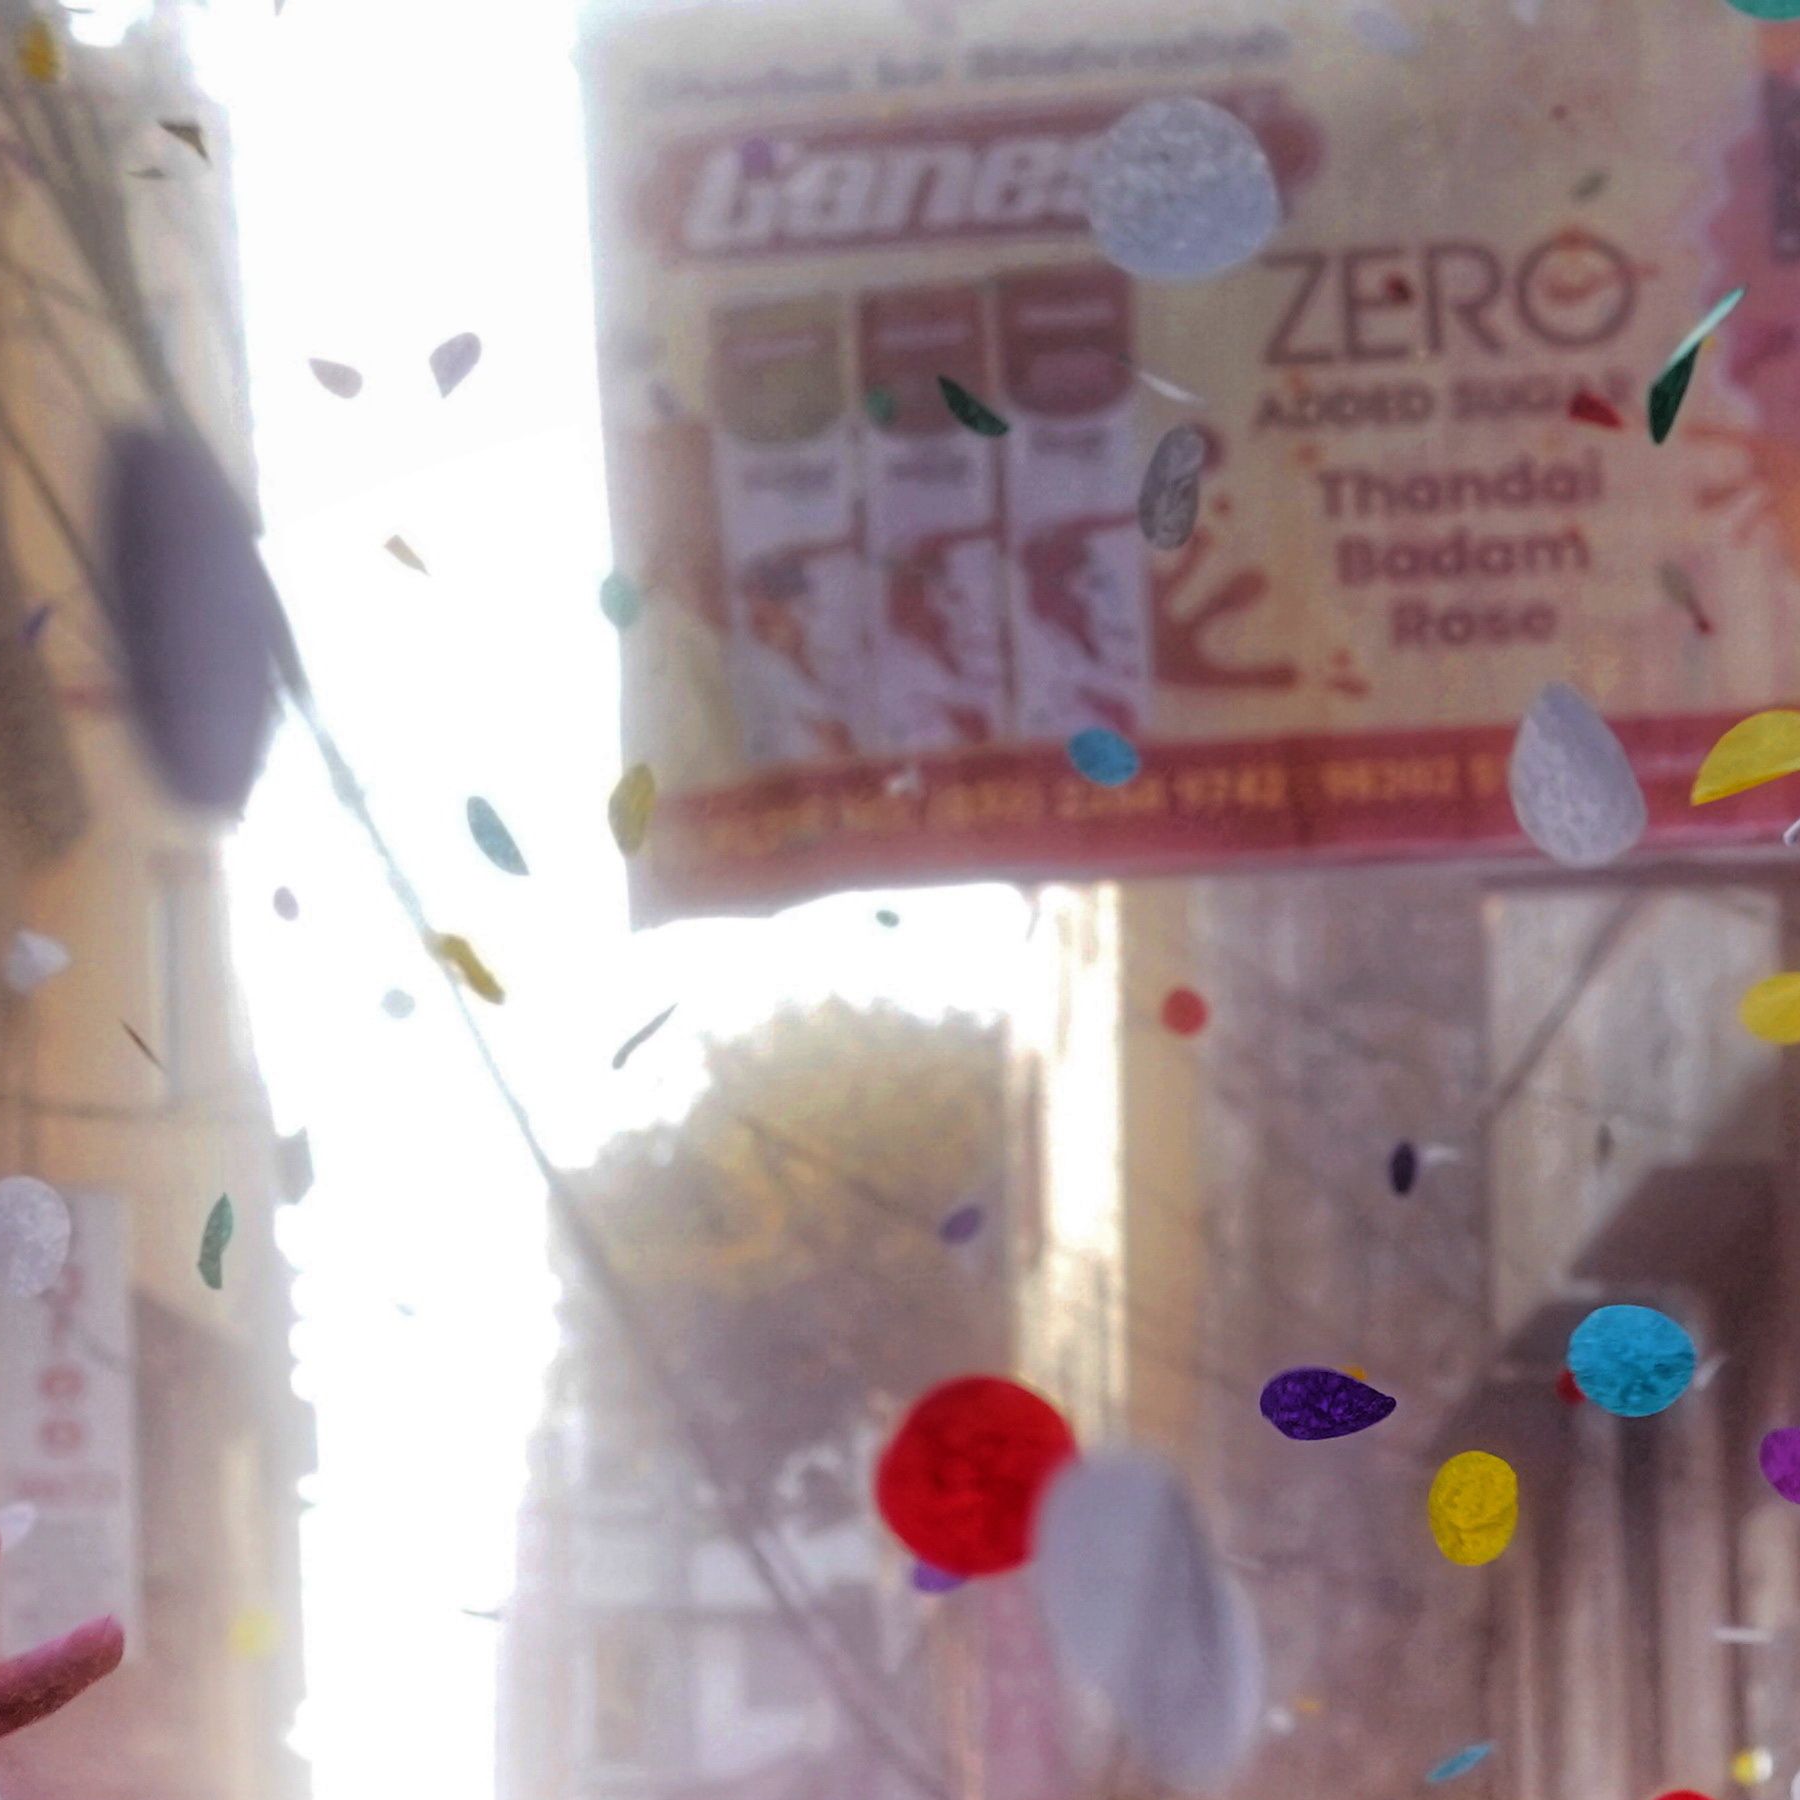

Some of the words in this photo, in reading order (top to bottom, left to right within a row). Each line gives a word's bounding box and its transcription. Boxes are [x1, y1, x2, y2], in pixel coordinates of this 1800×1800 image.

[1260, 230, 1638, 366] ZERO
[1316, 447, 1607, 518] Thandai
[1333, 524, 1592, 588] Badam
